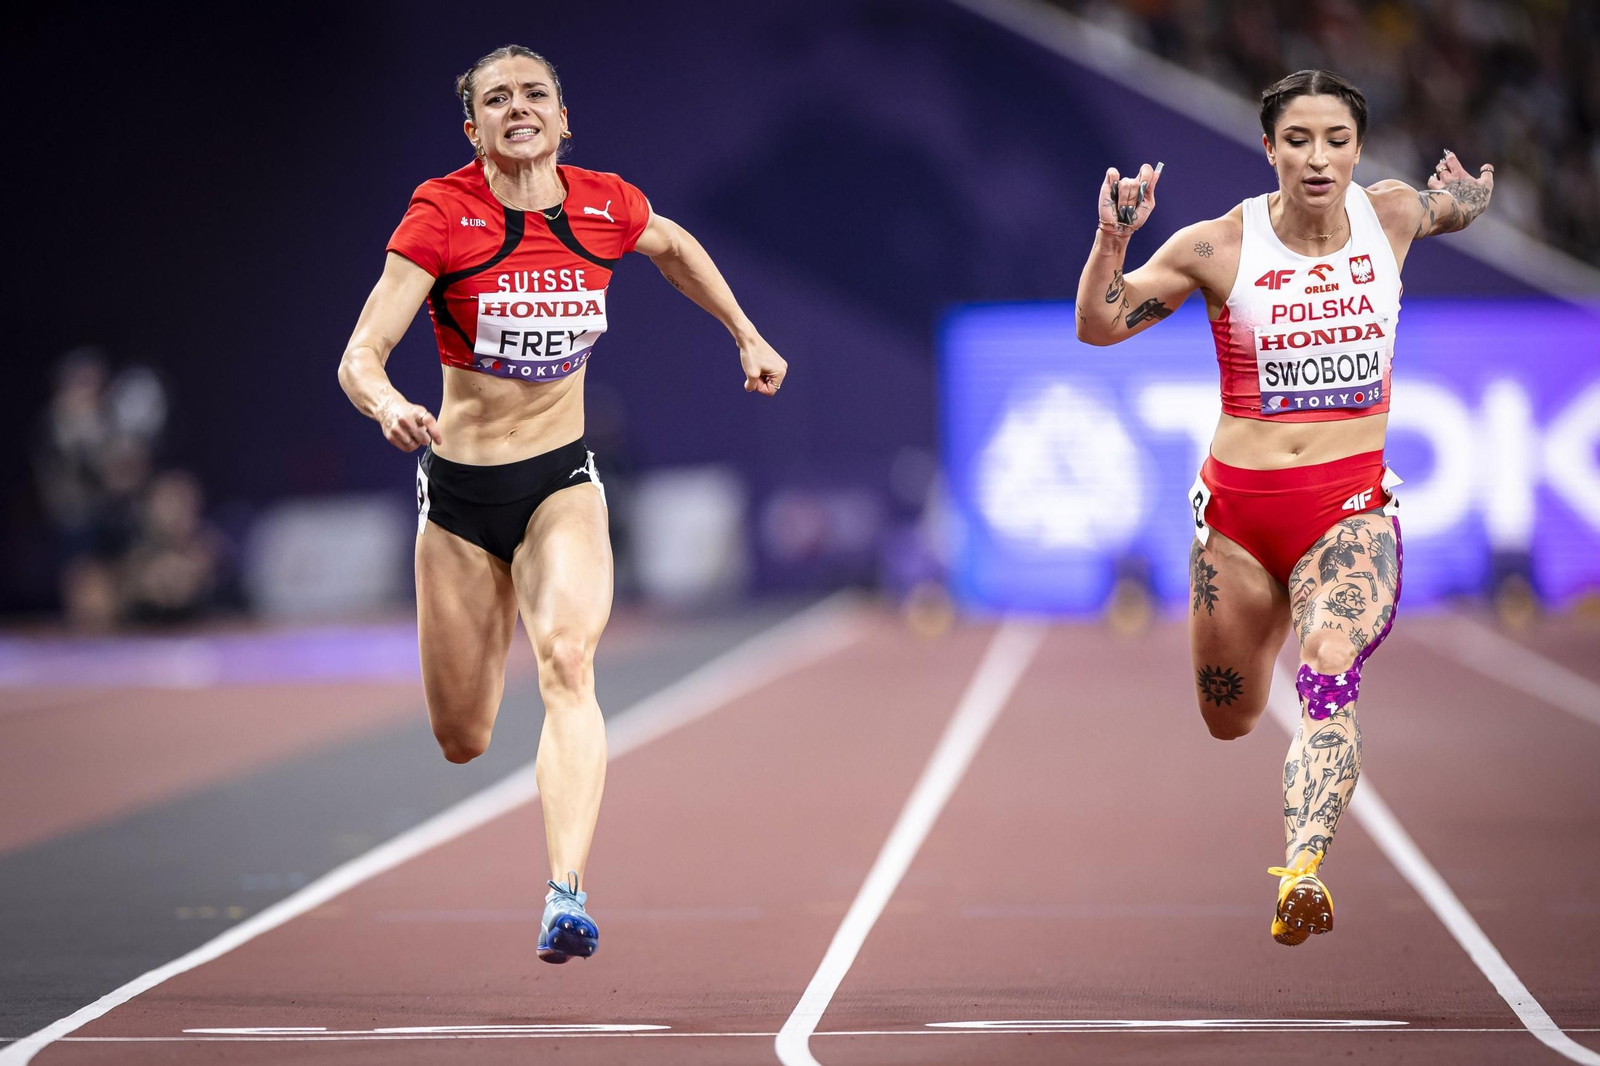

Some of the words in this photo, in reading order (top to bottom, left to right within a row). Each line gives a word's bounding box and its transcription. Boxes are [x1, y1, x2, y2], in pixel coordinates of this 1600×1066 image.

[469, 218, 487, 227] UBS
[1254, 270, 1296, 290] 4F
[1304, 283, 1339, 295] ORLEN
[481, 300, 603, 318] HONDA
[1271, 294, 1375, 324] POLSKA
[499, 329, 588, 357] FREY
[1258, 323, 1385, 351] HONDA
[1265, 351, 1380, 387] SWOBODA
[1368, 387, 1380, 401] 25
[1341, 486, 1374, 511] 4F
